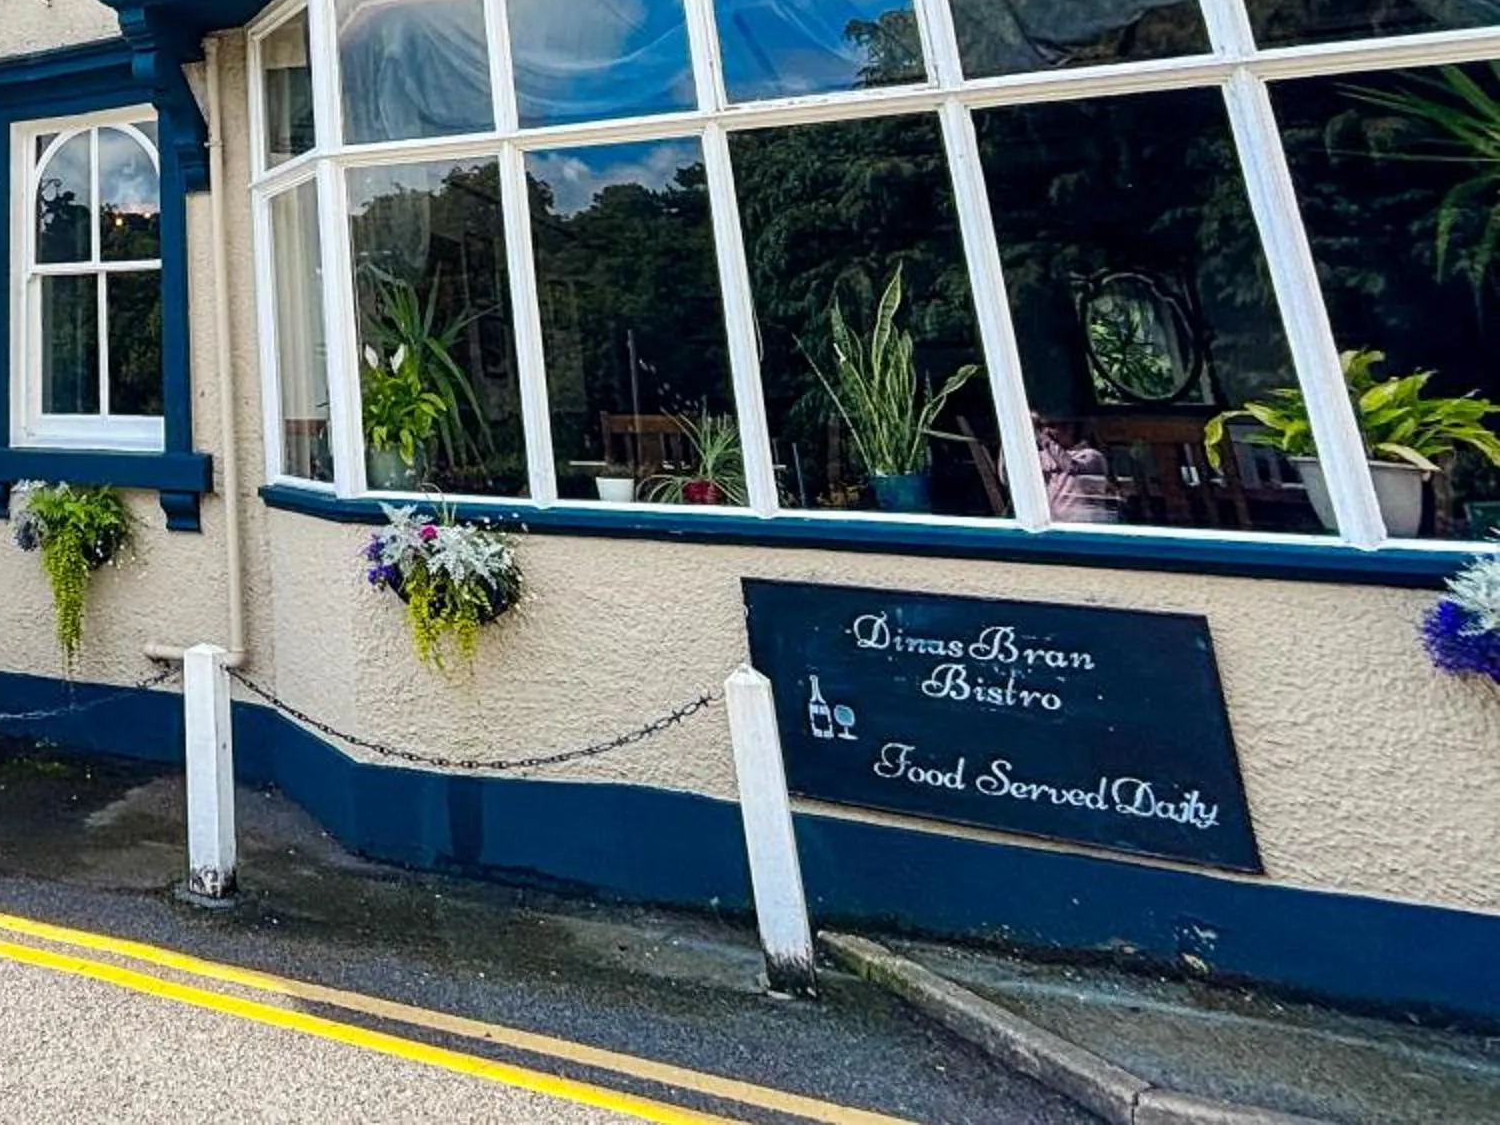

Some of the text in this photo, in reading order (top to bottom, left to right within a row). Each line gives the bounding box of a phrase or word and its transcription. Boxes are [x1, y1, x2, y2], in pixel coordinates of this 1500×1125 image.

[853, 611, 1095, 670] Dinas Bran
[921, 663, 1062, 711] Bistro
[873, 742, 1220, 829] Food Served Daily
